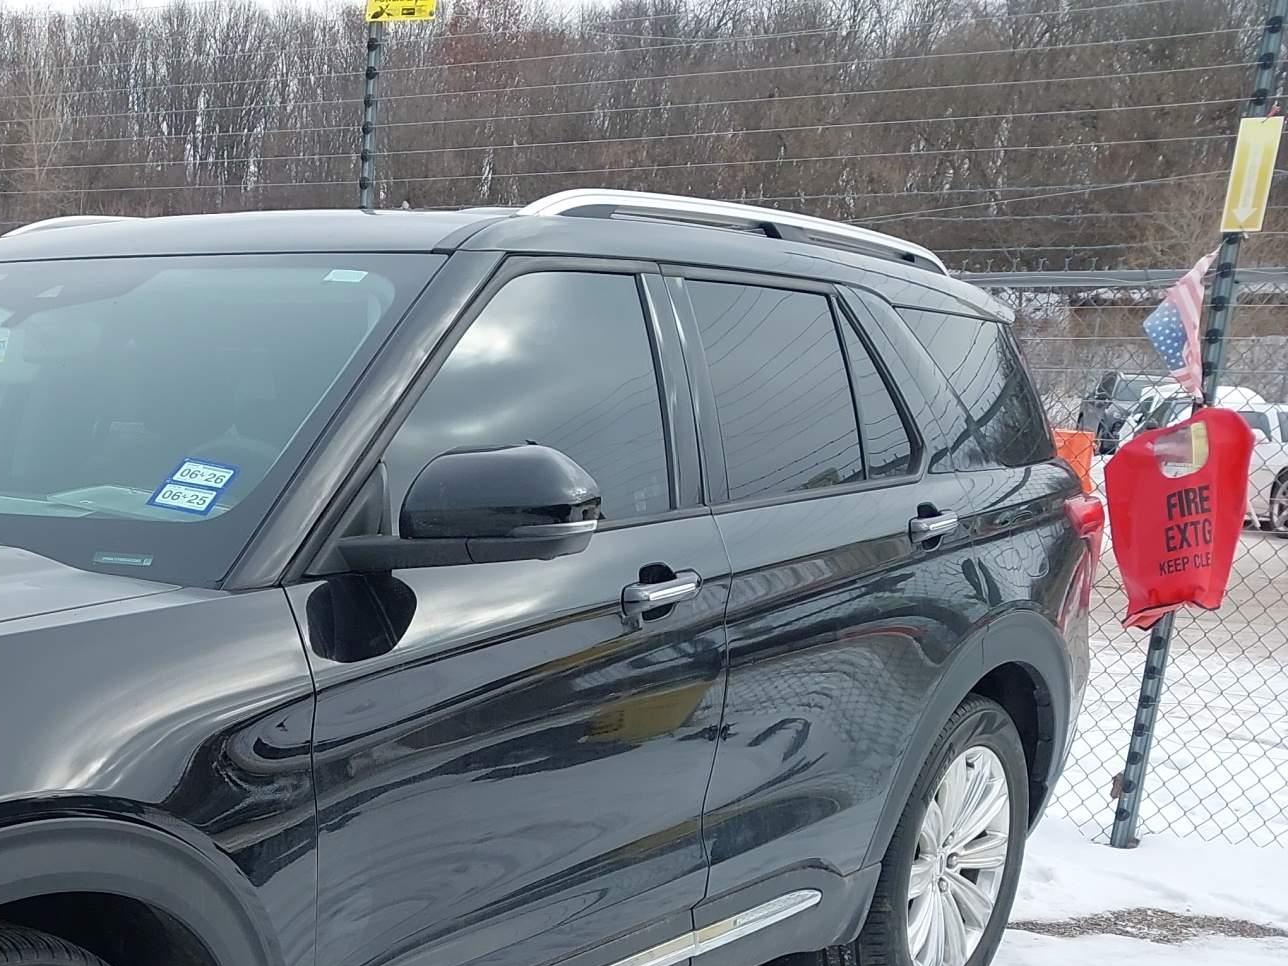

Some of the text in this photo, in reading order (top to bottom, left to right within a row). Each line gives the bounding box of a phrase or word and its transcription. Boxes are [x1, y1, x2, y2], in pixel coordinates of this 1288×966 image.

[180, 468, 201, 479] 06
[203, 472, 226, 485] 26
[162, 489, 182, 501] 06
[186, 494, 209, 506] 25
[1166, 485, 1212, 521] FIRE
[1159, 556, 1189, 577] KEEP
